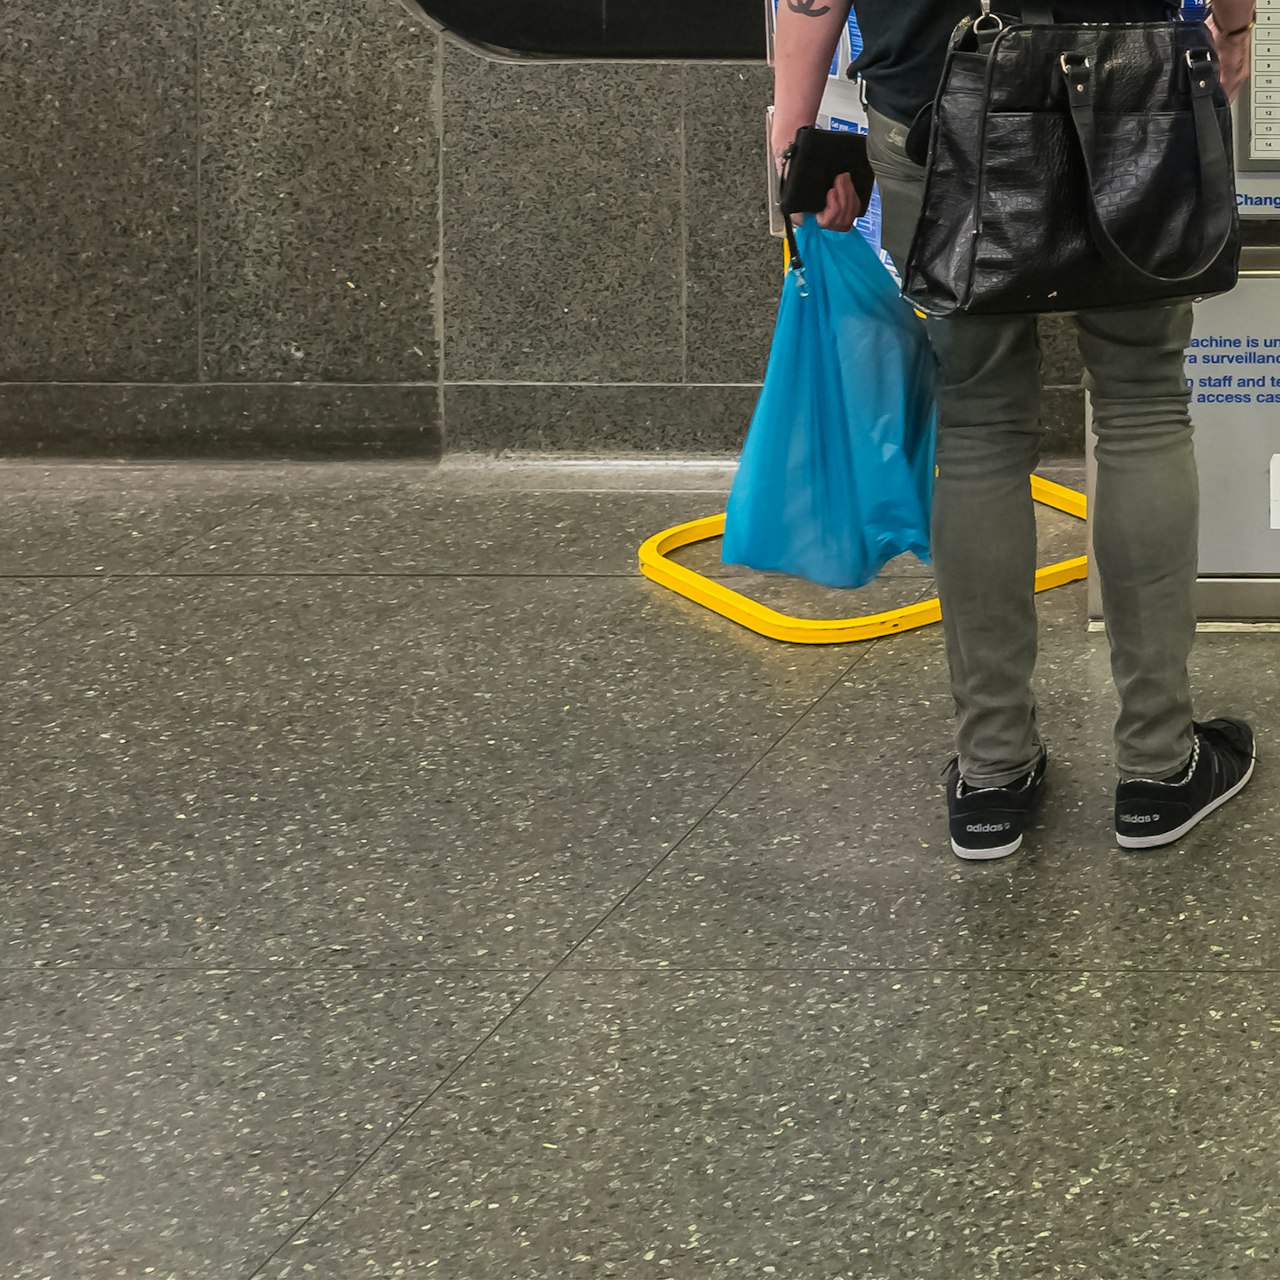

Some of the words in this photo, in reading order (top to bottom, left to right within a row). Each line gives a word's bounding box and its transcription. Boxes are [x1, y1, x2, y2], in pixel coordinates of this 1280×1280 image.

[1189, 336, 1242, 348] achine
[1246, 336, 1259, 348] is
[1198, 375, 1233, 388] staff
[1237, 375, 1266, 388] and
[1196, 393, 1251, 404] access
[1119, 814, 1151, 823] adidas
[966, 823, 1003, 833] adidas
